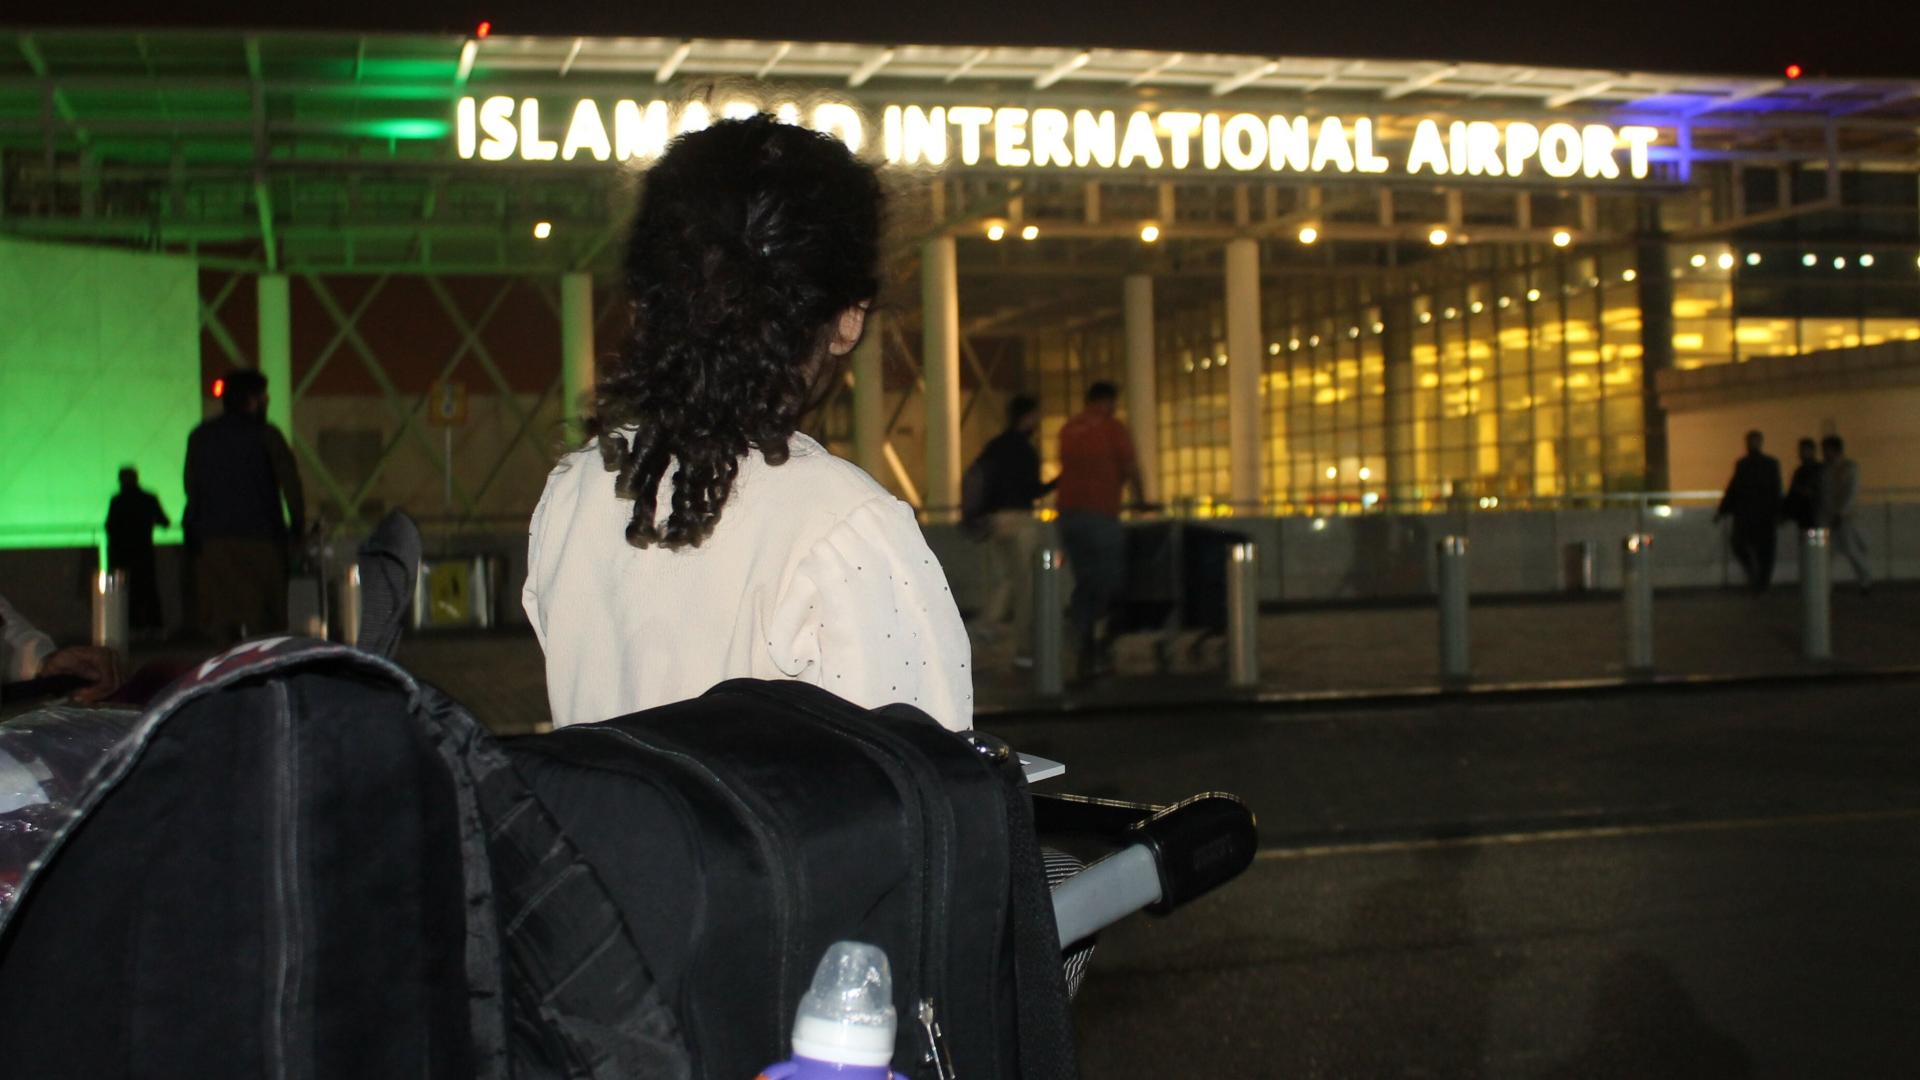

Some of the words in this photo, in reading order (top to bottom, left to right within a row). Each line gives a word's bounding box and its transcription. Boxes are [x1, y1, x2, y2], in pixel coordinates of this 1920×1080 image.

[457, 96, 864, 161] ISLAMD
[883, 106, 1390, 173] INTERNATIONAL
[1406, 120, 1659, 179] AIRPORT
